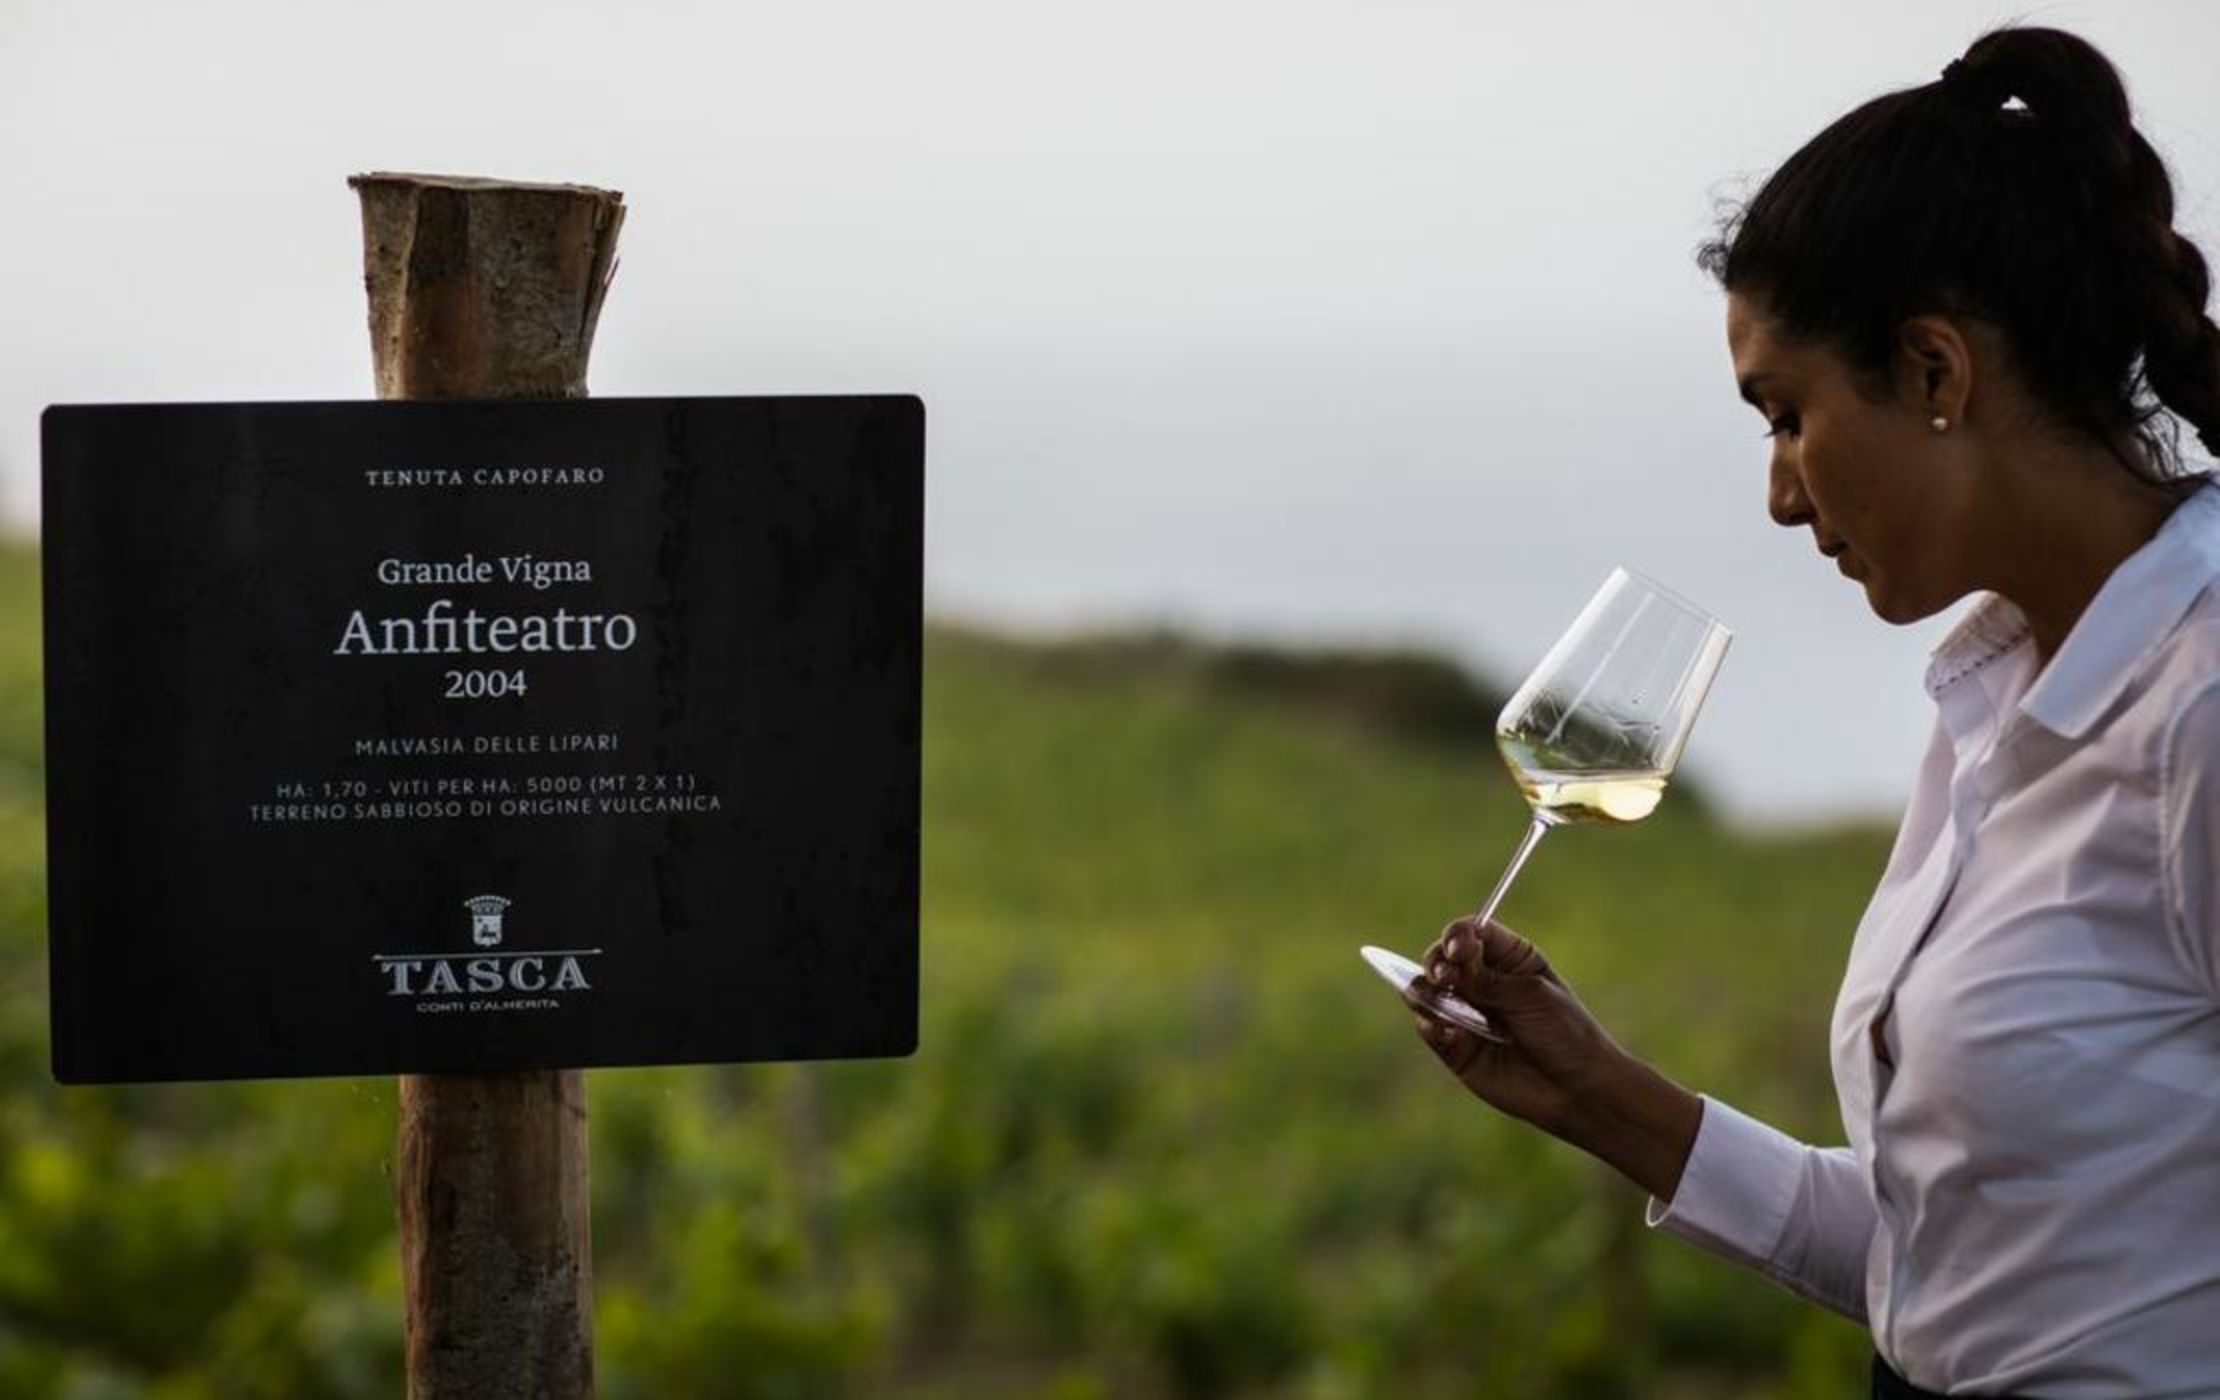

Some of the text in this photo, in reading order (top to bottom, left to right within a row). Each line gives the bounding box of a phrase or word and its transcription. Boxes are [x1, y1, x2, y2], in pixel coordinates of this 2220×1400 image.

[365, 467, 604, 486] TENUTA CAPOFARO
[377, 553, 591, 590] Grande Vigna
[333, 599, 637, 655] Anfiteatro
[445, 669, 528, 698] 2004
[355, 734, 617, 755] MALVASIA DELLE LIPARI
[388, 779, 429, 797] VITI
[437, 778, 474, 795] PER
[527, 776, 582, 794] 5000
[589, 775, 626, 794] (MT
[636, 774, 647, 791] 2
[655, 775, 666, 790] X
[676, 773, 695, 792] 1)
[251, 795, 721, 821] TERRENO SABBIOSO DI ORIGINE VULCANICA
[379, 957, 591, 995] TASCA
[416, 1001, 464, 1013] CONTI
